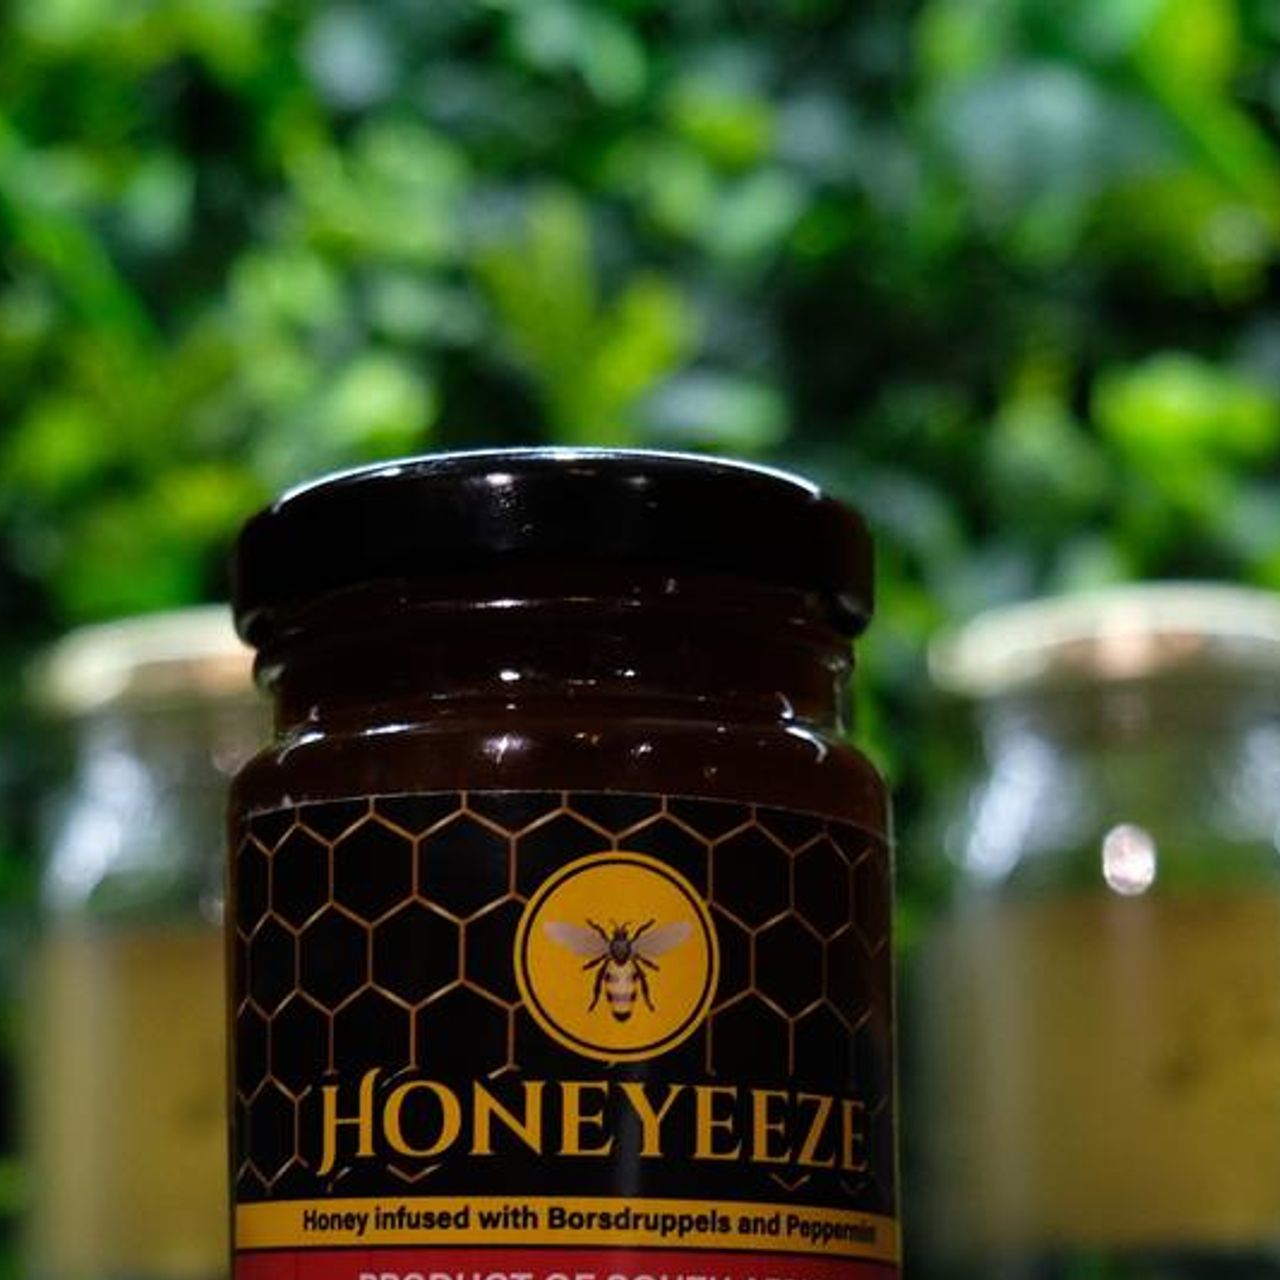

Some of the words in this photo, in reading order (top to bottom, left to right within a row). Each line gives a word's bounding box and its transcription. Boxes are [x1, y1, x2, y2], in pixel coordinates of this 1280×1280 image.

[316, 1066, 869, 1177] HONEYEEZE
[303, 1208, 367, 1236] Honey
[375, 1205, 469, 1230] infused
[479, 1205, 537, 1229] with
[547, 1206, 730, 1238] Borsdruppels
[738, 1213, 780, 1236] and
